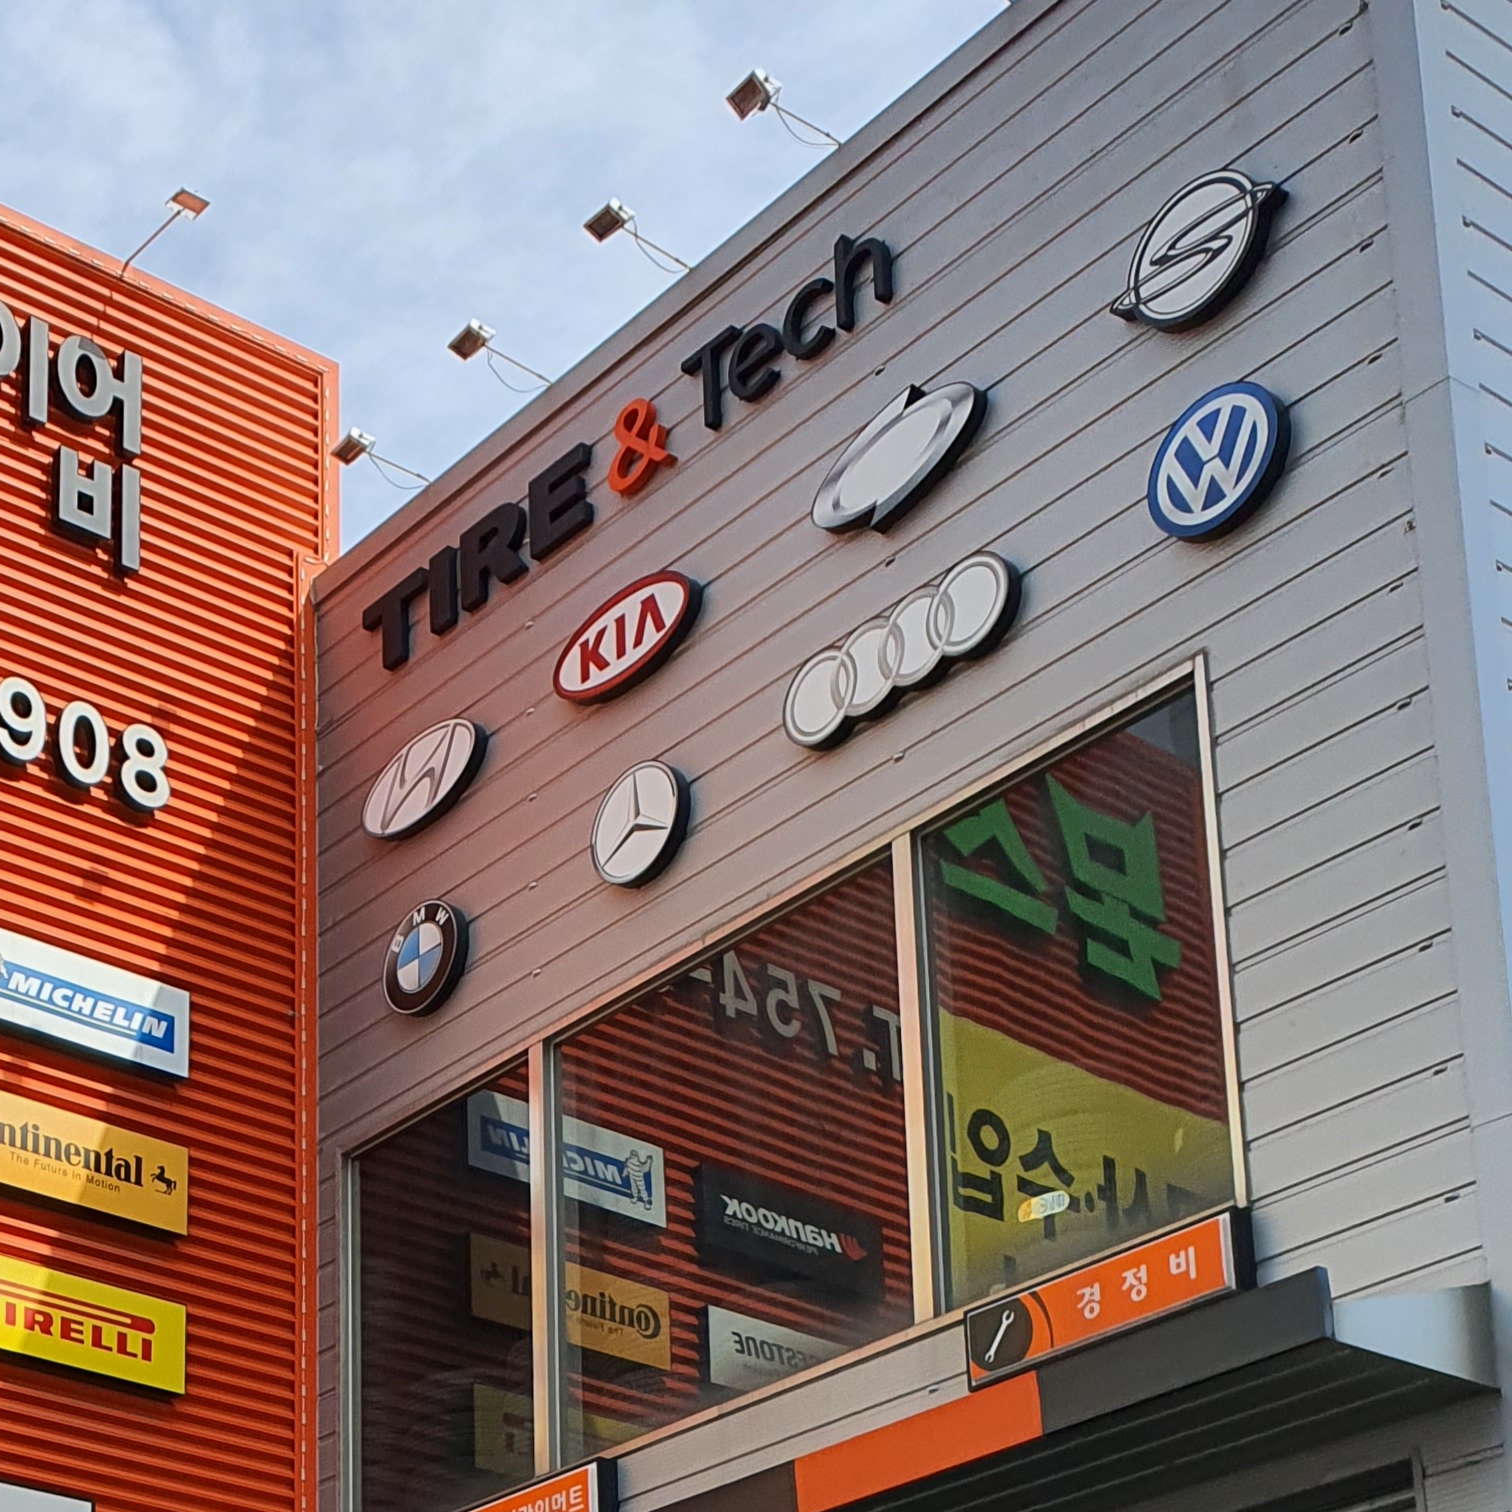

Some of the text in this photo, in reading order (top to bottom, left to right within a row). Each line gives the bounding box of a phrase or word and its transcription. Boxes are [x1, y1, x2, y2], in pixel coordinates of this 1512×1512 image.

[361, 233, 894, 670] TIRE & Tech
[579, 598, 666, 685] KIA
[8, 969, 168, 1039] MICHELIN
[9, 1150, 30, 1166] The
[33, 1157, 68, 1178] Future
[85, 1173, 121, 1193] Motion
